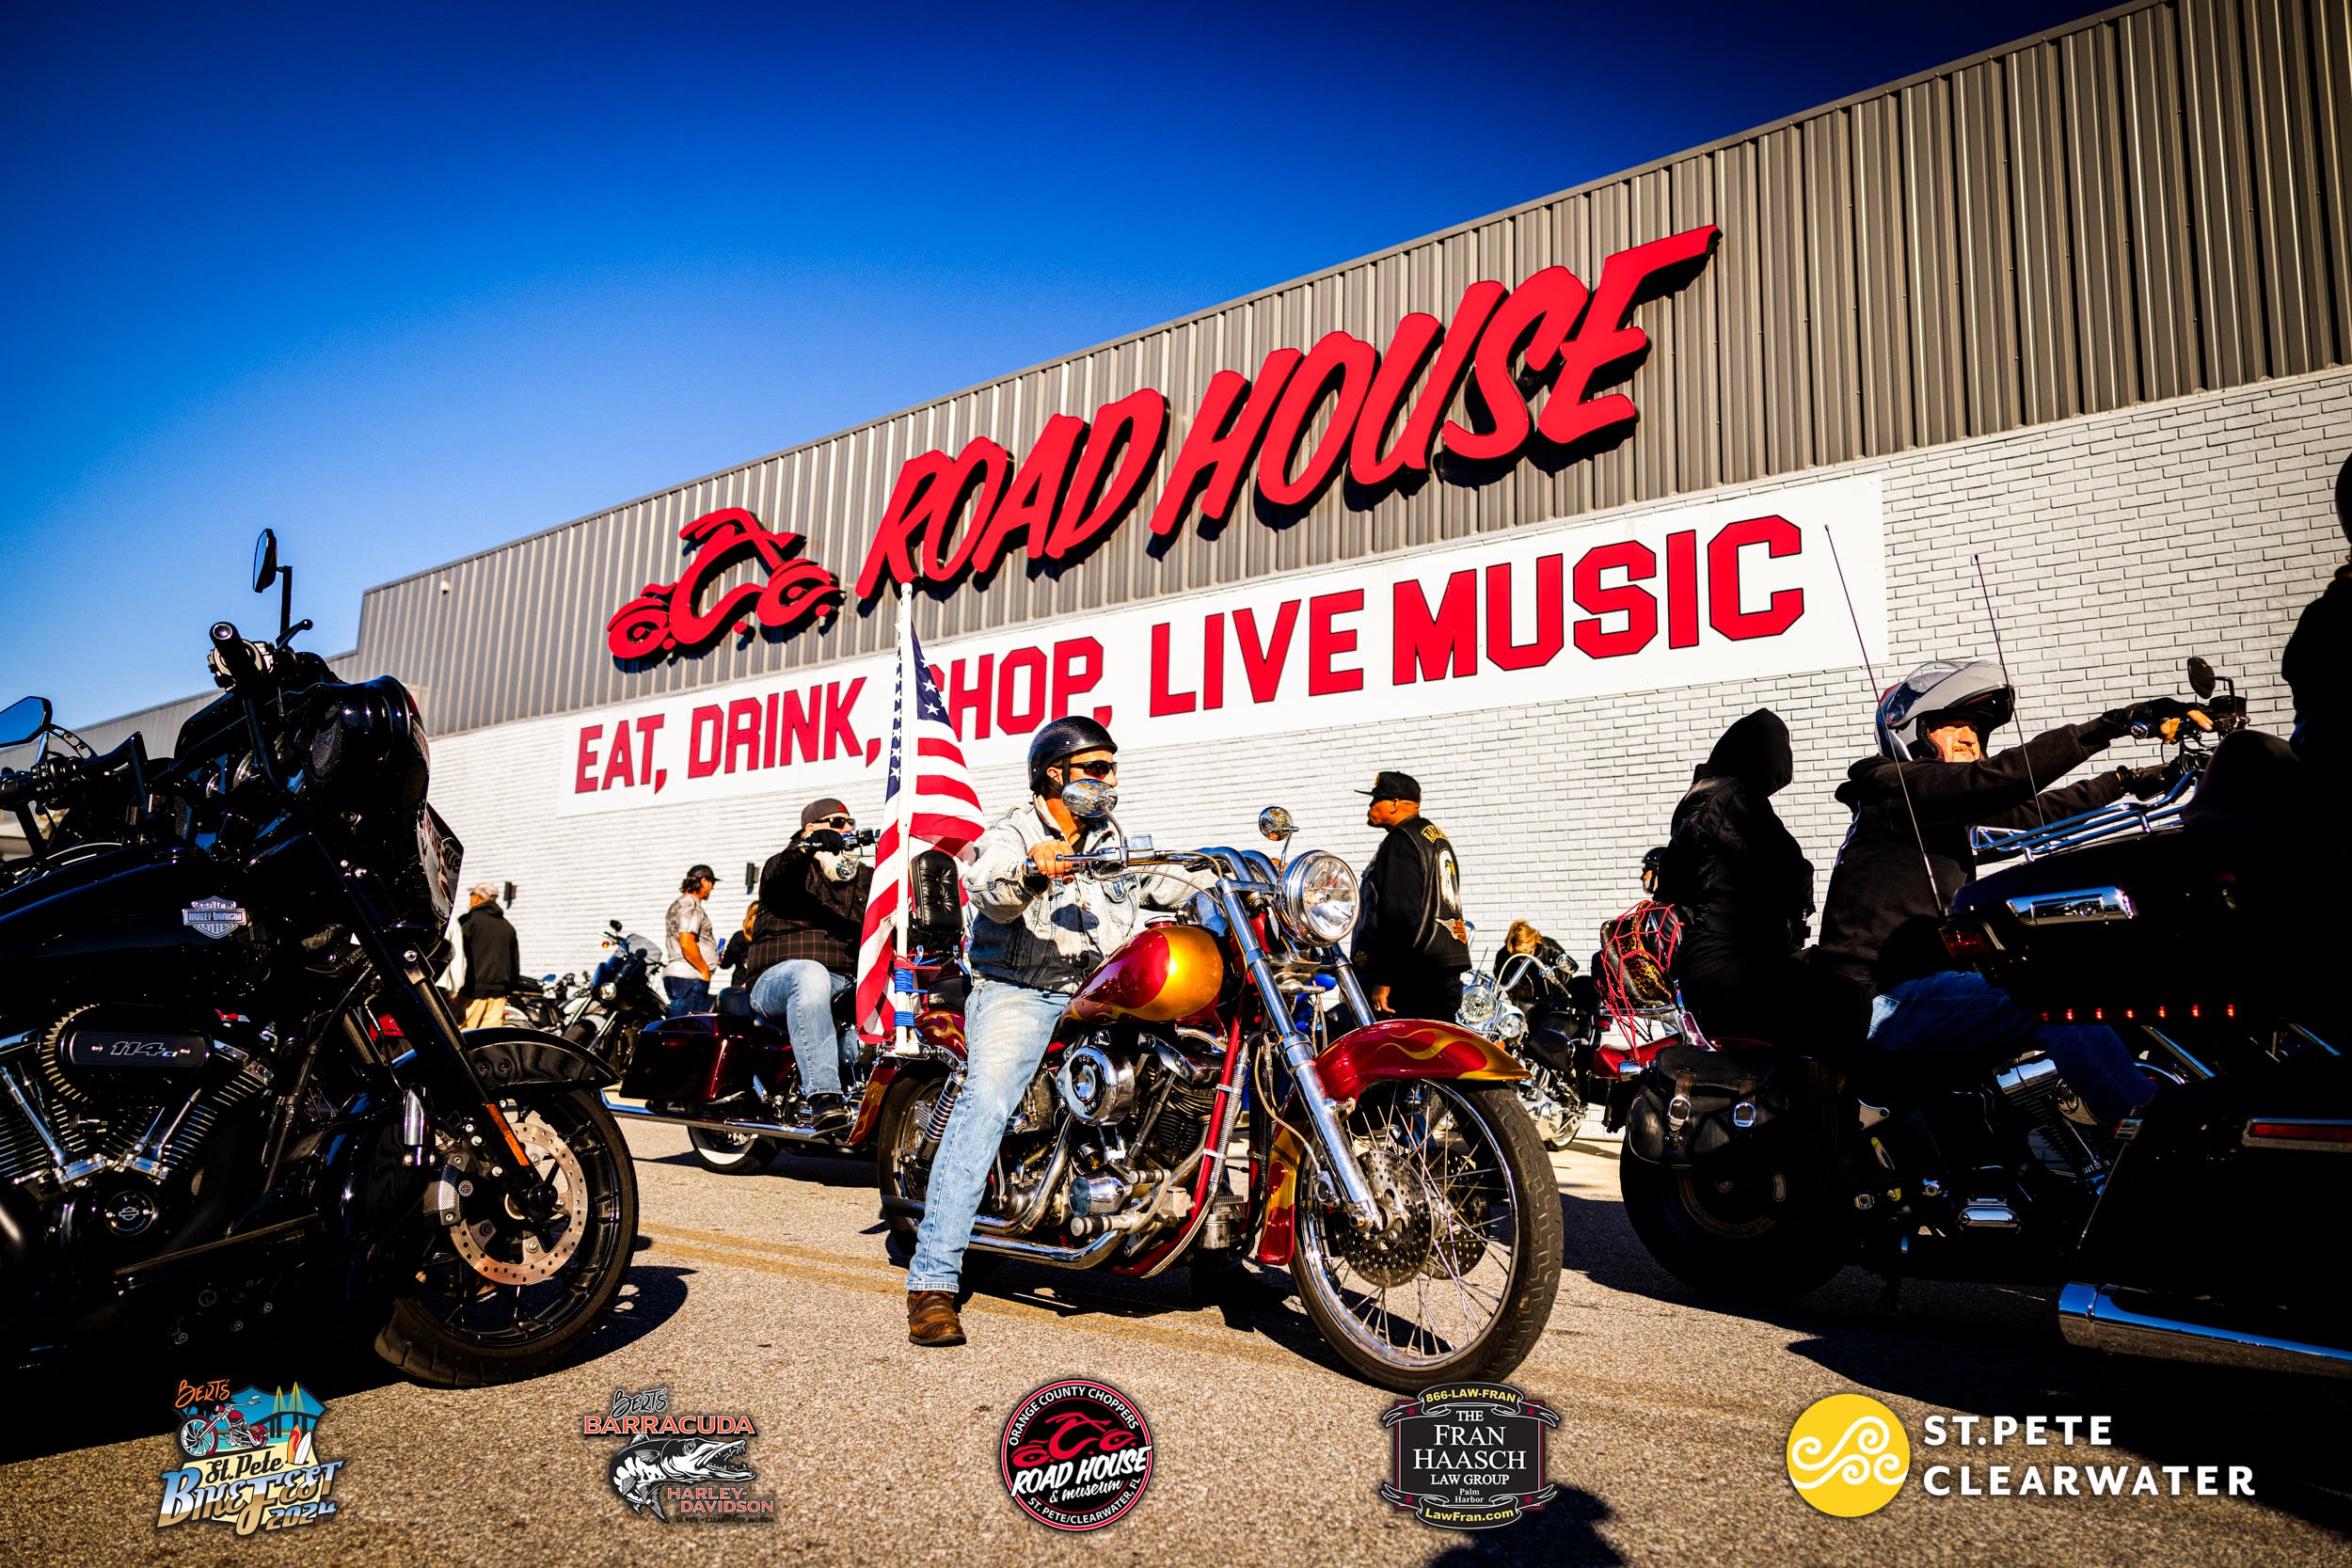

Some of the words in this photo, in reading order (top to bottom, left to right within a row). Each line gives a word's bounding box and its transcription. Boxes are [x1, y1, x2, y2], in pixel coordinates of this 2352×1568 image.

[855, 388, 1167, 600] ROAD
[1150, 225, 1720, 536] HOUSE
[575, 714, 667, 794] EAT,
[688, 676, 882, 780] DRINK,
[929, 636, 1113, 741] HOP,
[1150, 590, 1363, 717] LIVE
[1393, 515, 1804, 685] MUSIC
